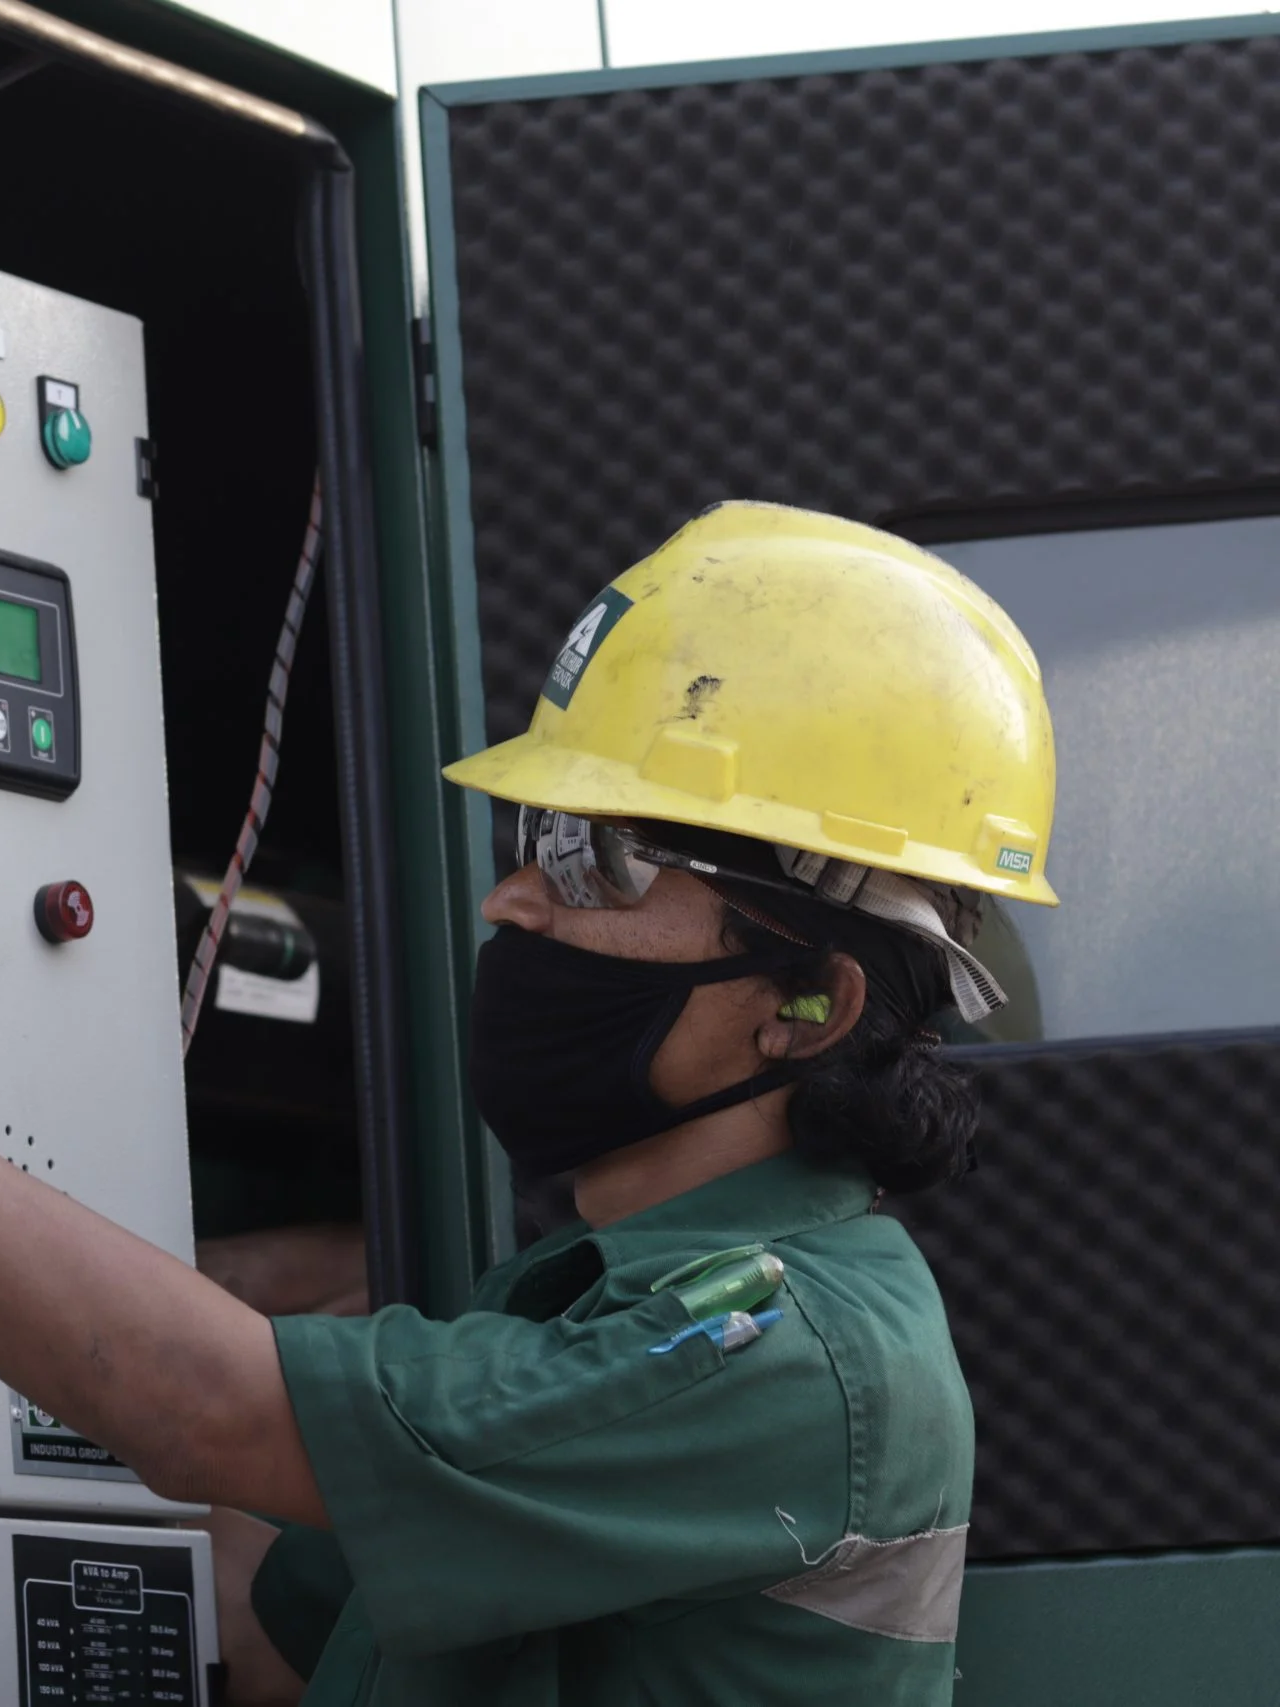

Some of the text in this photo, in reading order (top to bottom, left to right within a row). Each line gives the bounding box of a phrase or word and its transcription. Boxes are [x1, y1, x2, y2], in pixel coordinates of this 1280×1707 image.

[57, 388, 63, 401] T
[1000, 850, 1031, 871] MSA
[83, 1565, 130, 1581] kVA to Amp
